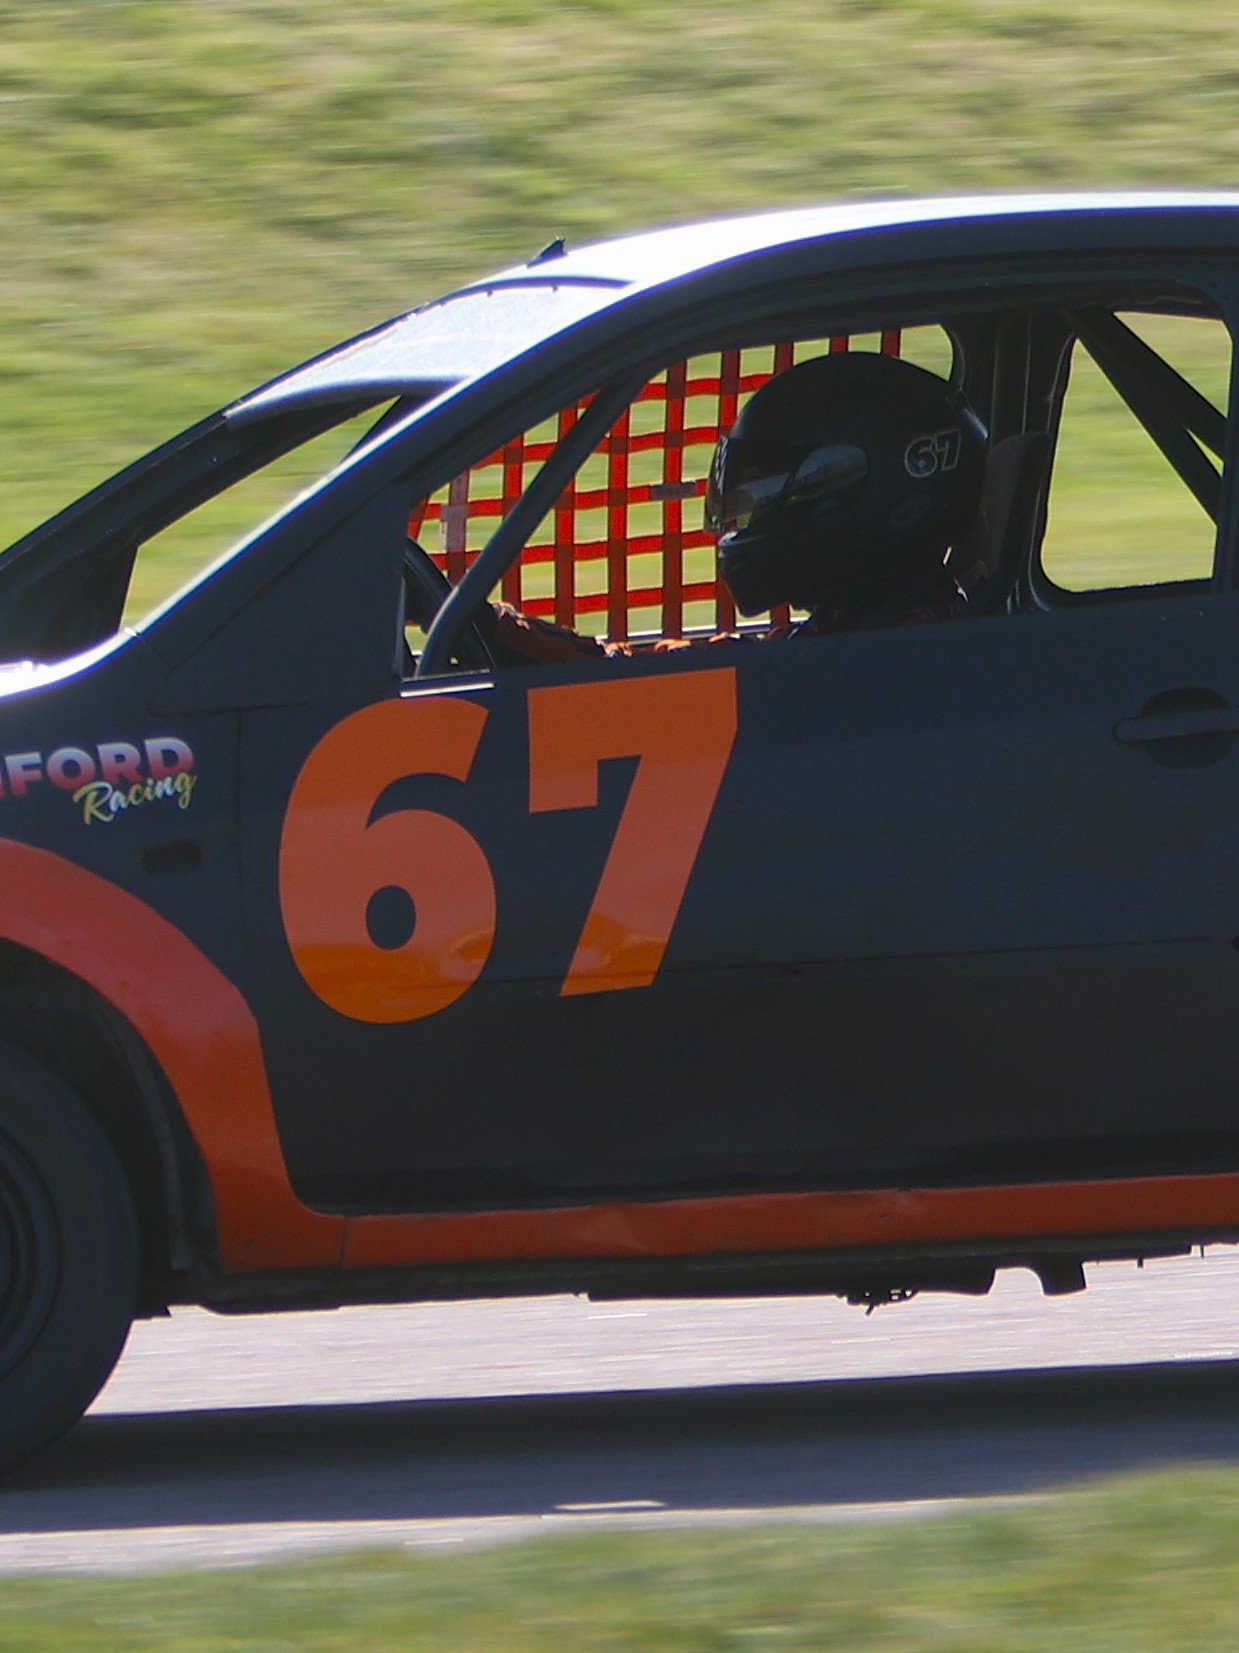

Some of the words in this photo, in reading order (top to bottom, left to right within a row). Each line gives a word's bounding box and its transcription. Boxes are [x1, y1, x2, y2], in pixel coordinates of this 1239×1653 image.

[903, 429, 960, 478] 67
[72, 772, 198, 825] Racing
[278, 666, 738, 1024] 67
